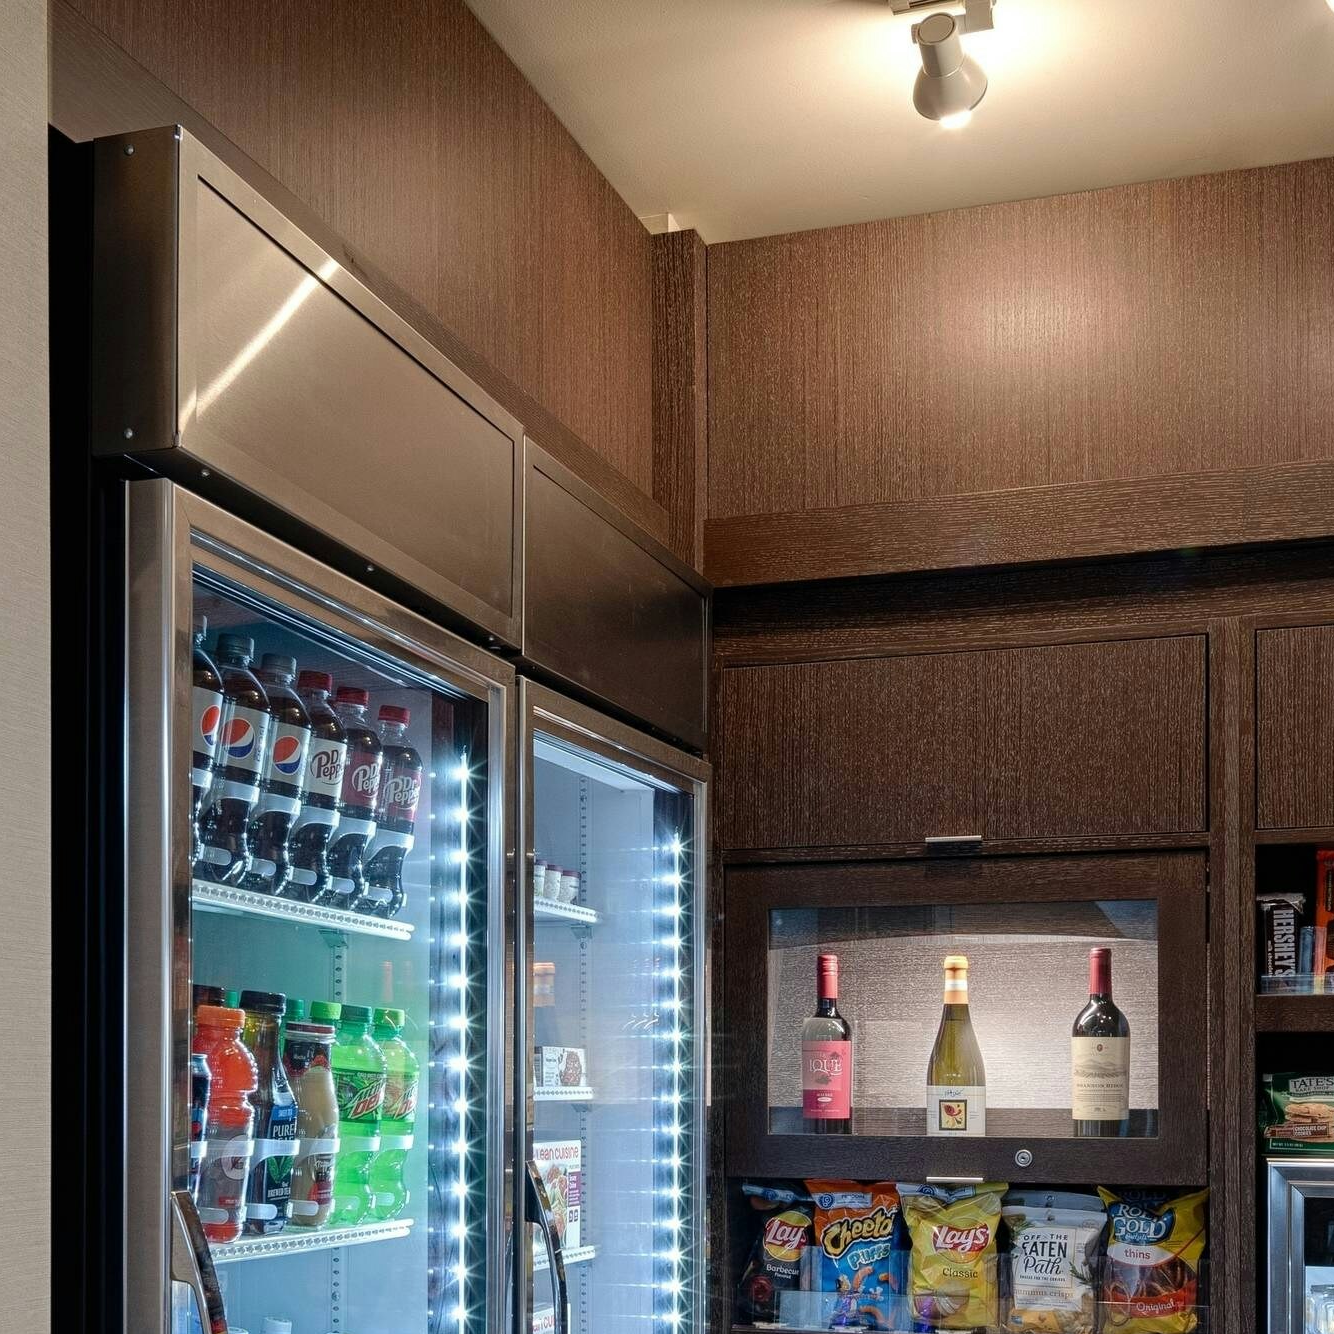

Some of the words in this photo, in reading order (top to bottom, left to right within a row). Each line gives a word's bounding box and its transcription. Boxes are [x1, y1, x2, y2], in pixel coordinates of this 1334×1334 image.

[1291, 1077, 1334, 1088] TATE'S
[272, 1124, 294, 1138] PURE
[1113, 1217, 1166, 1238] GOLD
[935, 1225, 990, 1252] Lay's
[1124, 1249, 1151, 1260] thins
[942, 1268, 978, 1279] Classic
[1023, 1256, 1063, 1276] Path
[1136, 1298, 1175, 1314] Original
